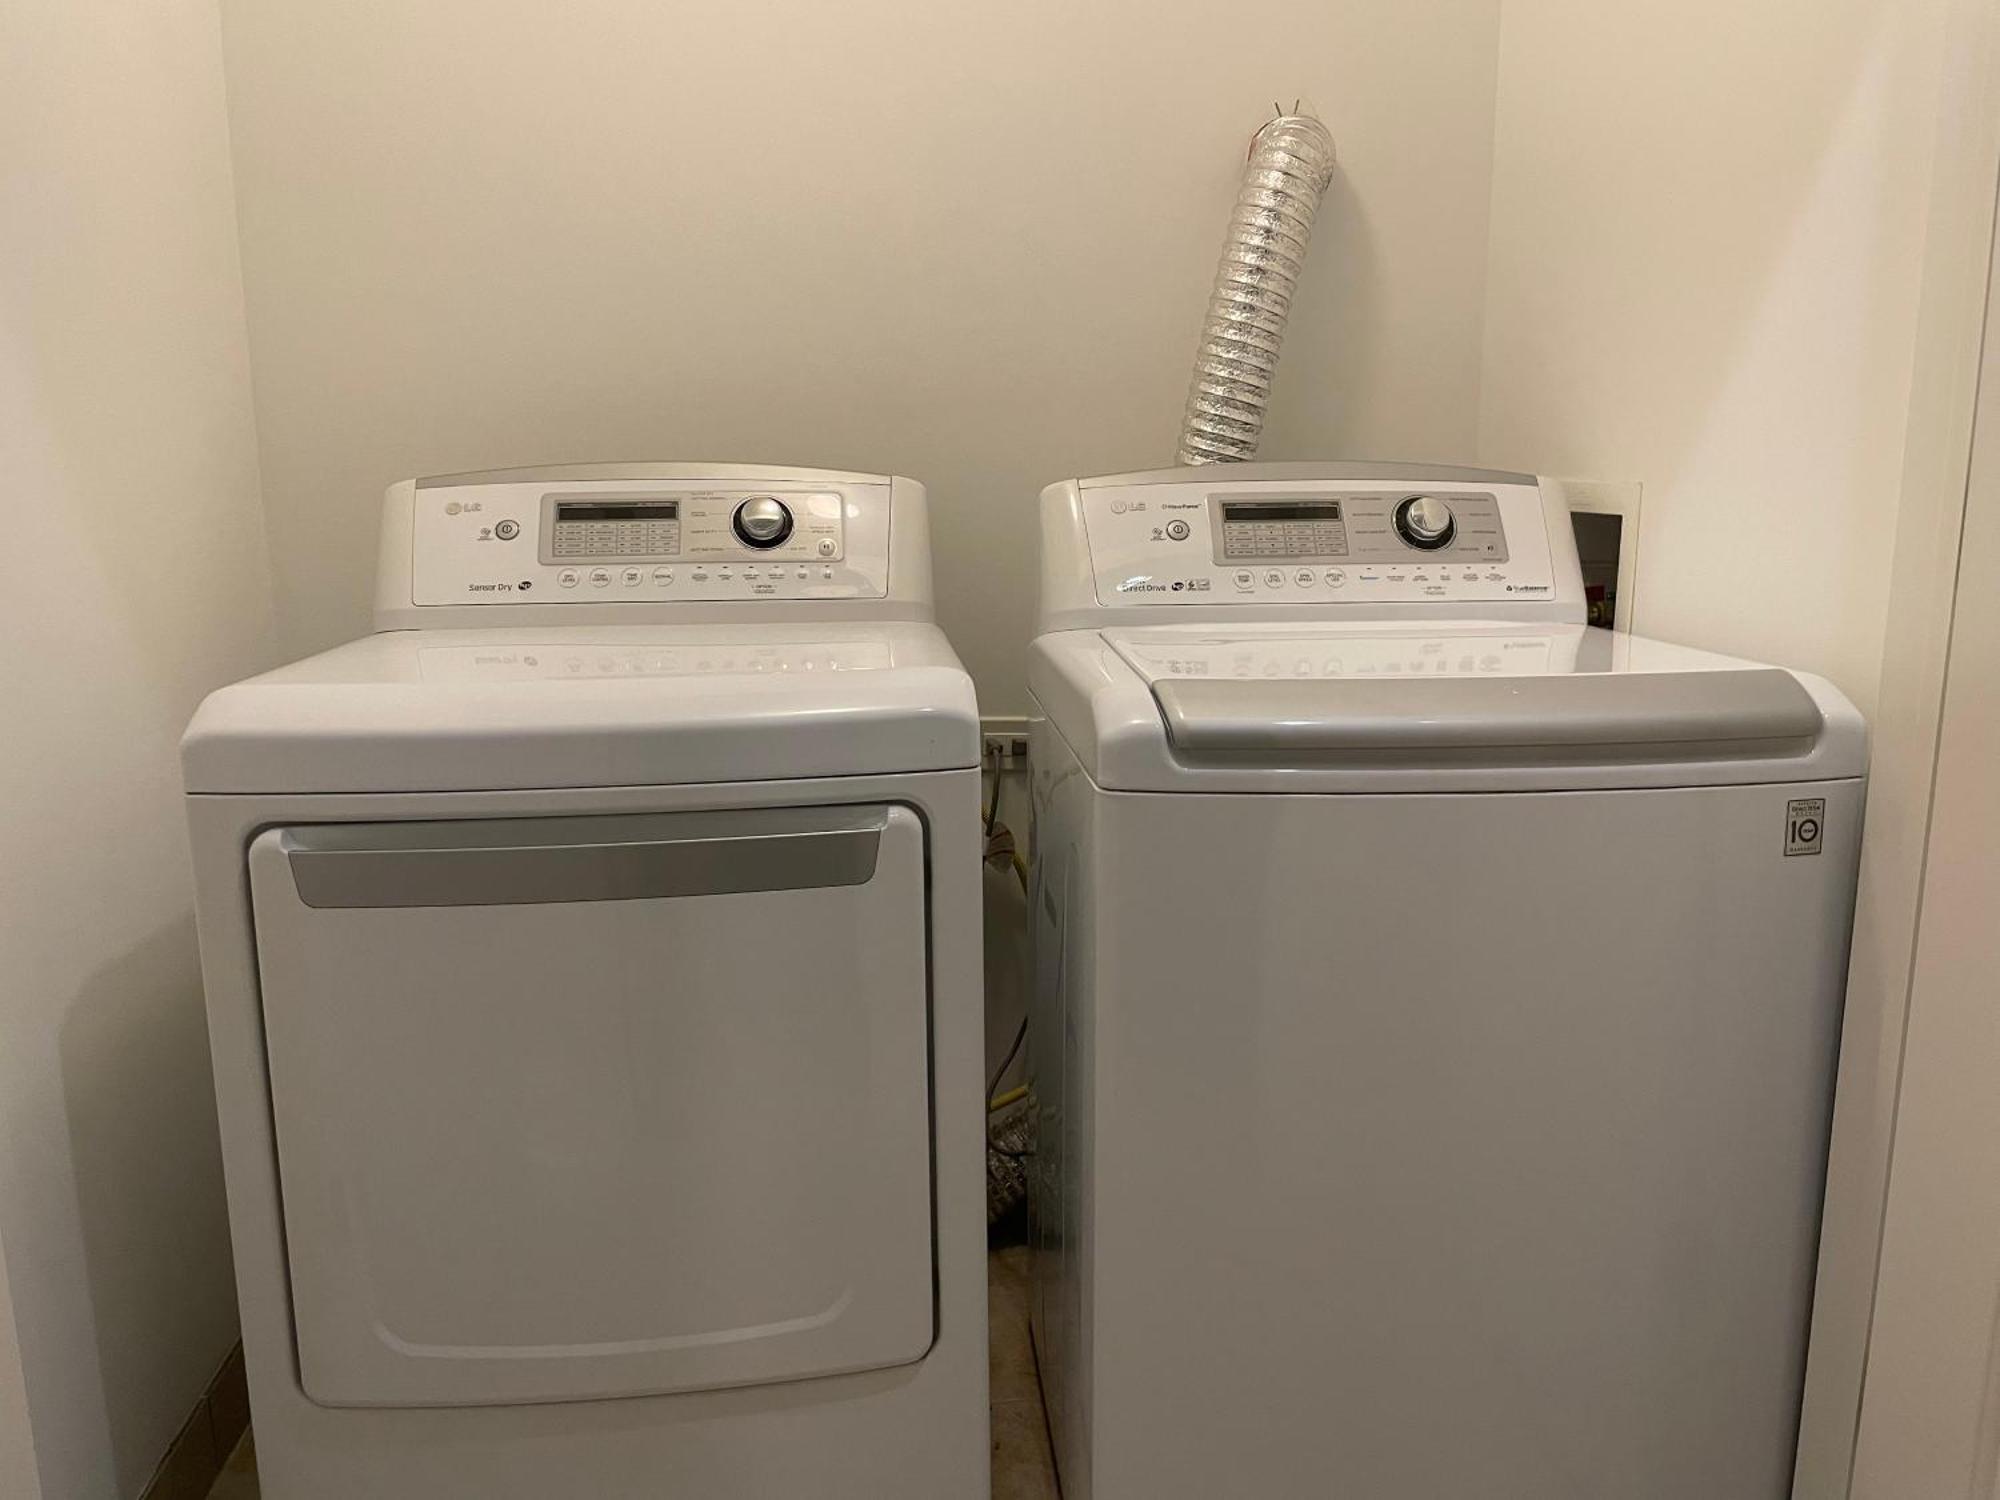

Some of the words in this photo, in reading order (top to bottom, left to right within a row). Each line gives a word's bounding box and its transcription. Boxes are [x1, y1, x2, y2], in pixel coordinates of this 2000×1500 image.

[469, 584, 496, 592] Sensor
[498, 584, 512, 592] Dry
[1146, 584, 1167, 592] Drive
